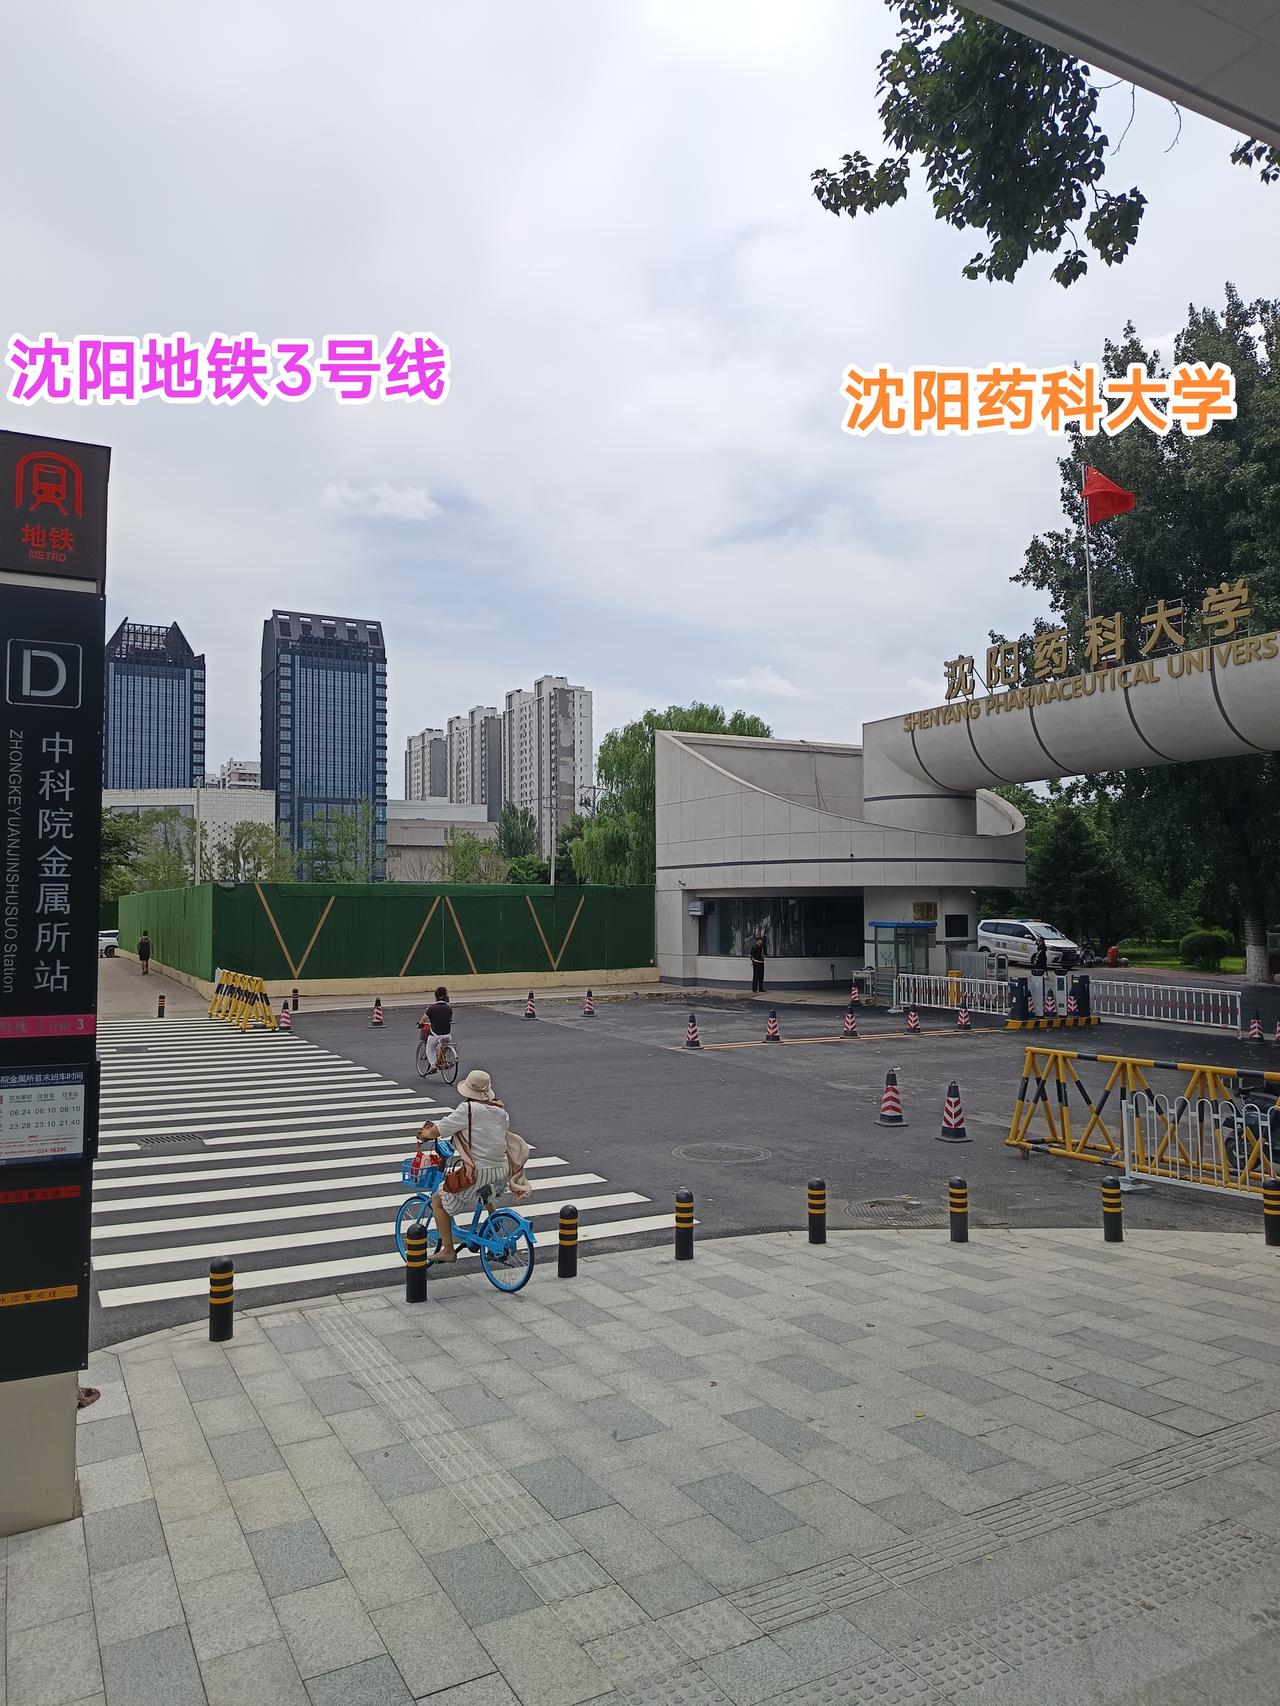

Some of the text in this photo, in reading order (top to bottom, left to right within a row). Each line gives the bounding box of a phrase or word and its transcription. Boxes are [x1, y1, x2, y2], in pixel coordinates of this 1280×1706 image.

[21, 523, 75, 552] 地铁
[29, 550, 67, 562] METRO
[22, 649, 68, 698] D
[903, 633, 1280, 733] SHENYANG PHARMACEUTICAL UNIVERS
[944, 579, 1252, 700] 沈阳药科大学
[2, 729, 24, 993] ZHONGKEYUANJINSHUSUO Station
[34, 731, 75, 992] 中科院金属所站
